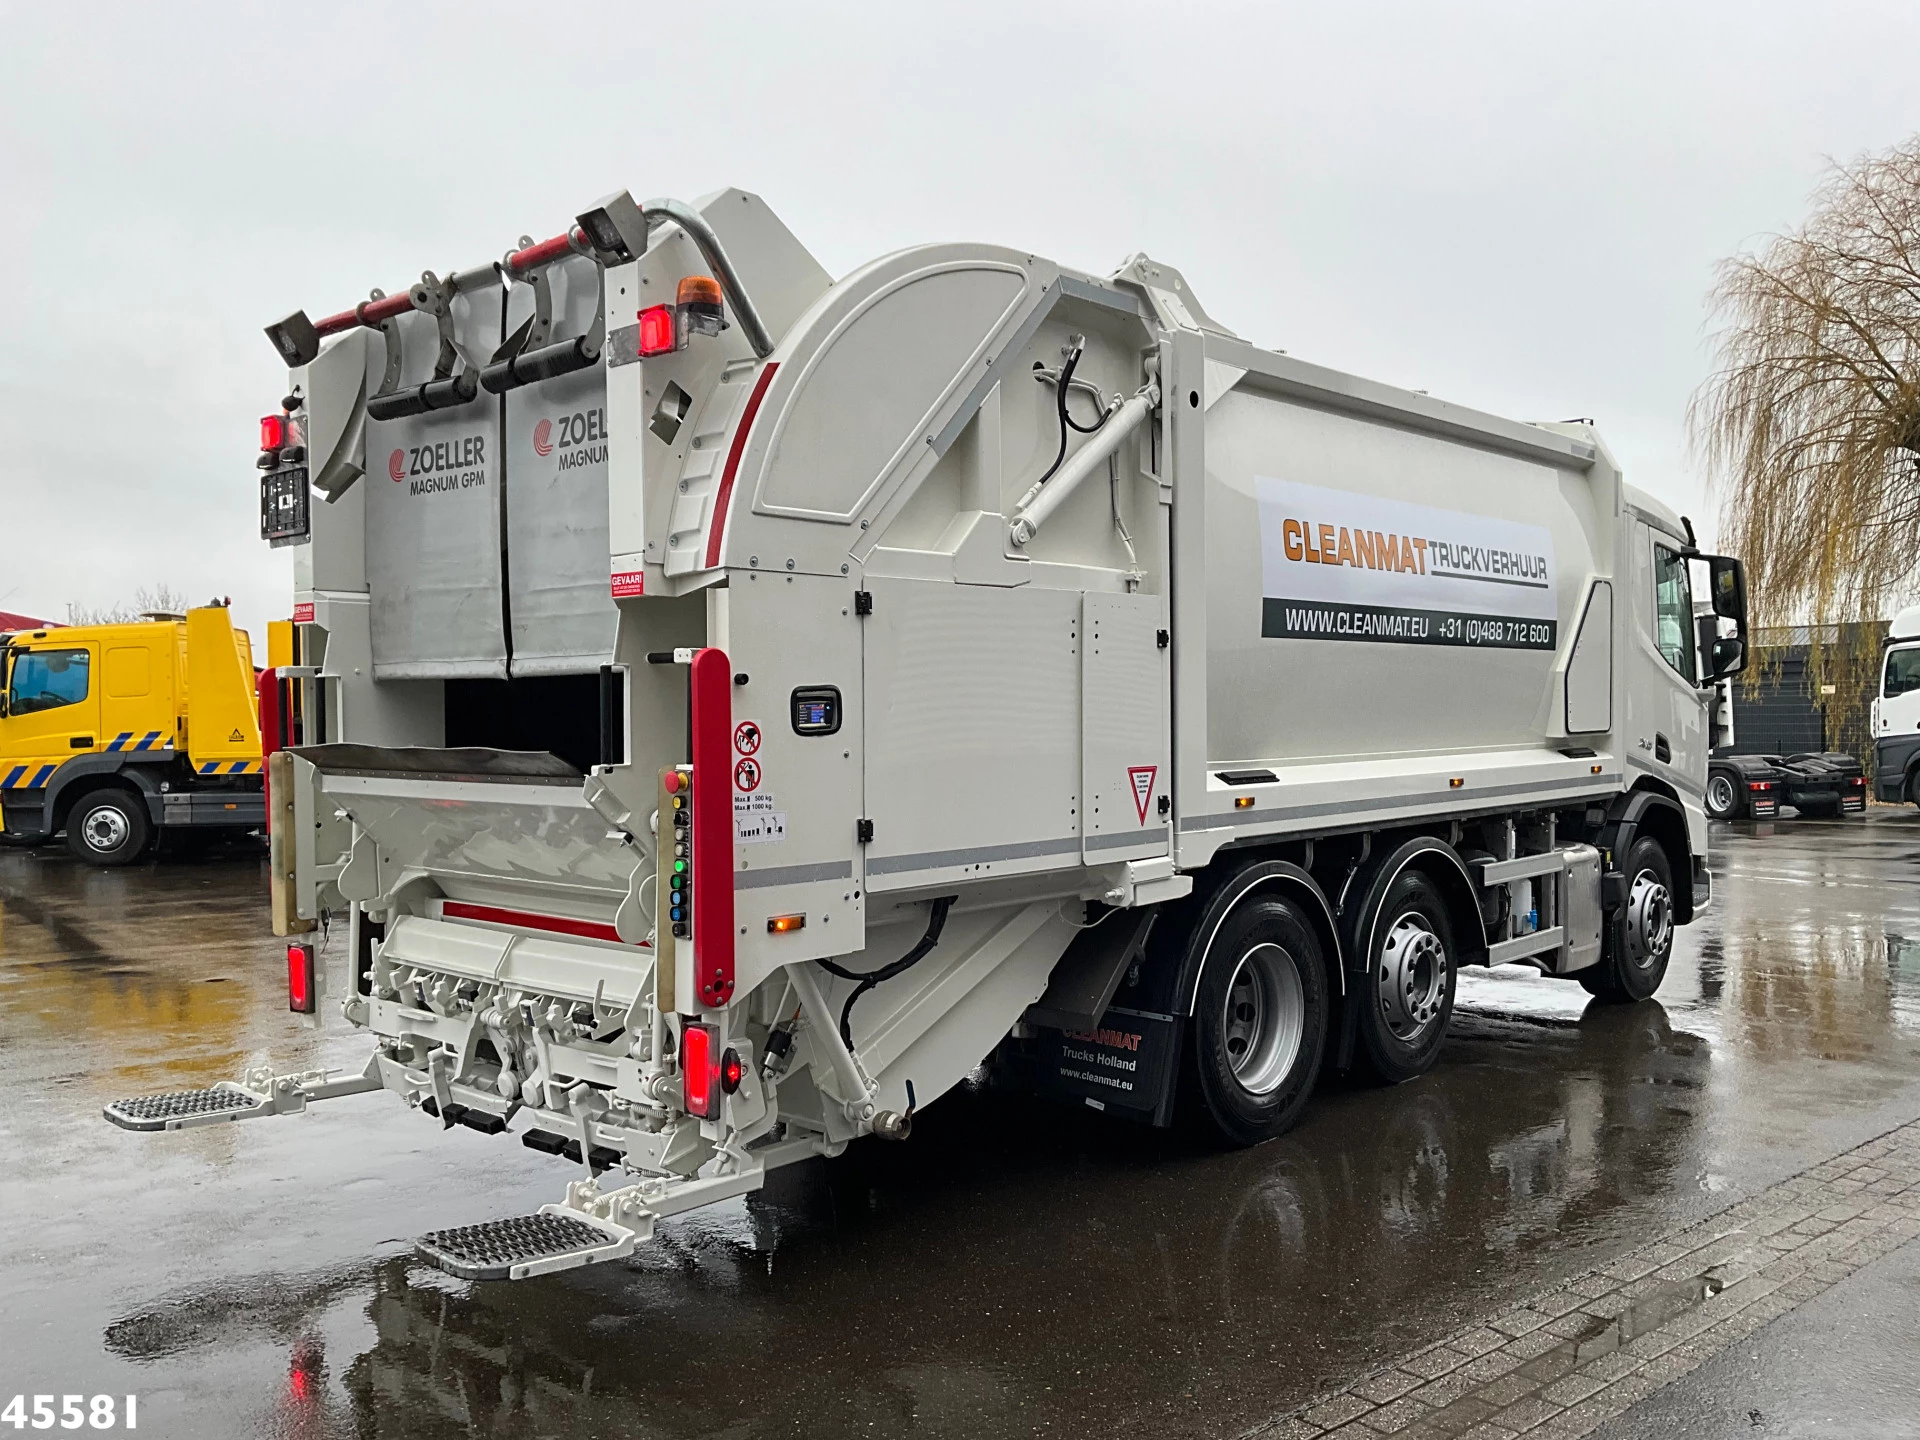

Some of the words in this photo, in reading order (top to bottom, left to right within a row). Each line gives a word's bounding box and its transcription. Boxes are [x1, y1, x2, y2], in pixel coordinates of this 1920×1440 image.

[559, 408, 608, 448] ZOEL
[410, 436, 485, 475] ZOELLER
[410, 475, 458, 496] MAGNUM
[461, 470, 485, 489] GPM
[1283, 518, 1427, 575] CLEANMAT
[1428, 540, 1547, 580] TRUCKVERHUUR
[611, 574, 642, 586] GEVAAR!
[1285, 607, 1429, 638] WWW.CLEANMAT.EU
[1438, 618, 1462, 639] +31
[1466, 619, 1503, 644] (0)488
[1507, 622, 1527, 643] 712
[1529, 624, 1550, 644] 600
[1062, 1045, 1094, 1063] Trucks
[1096, 1052, 1137, 1072] Holland
[1060, 1067, 1133, 1091] www.cleanmat.eu
